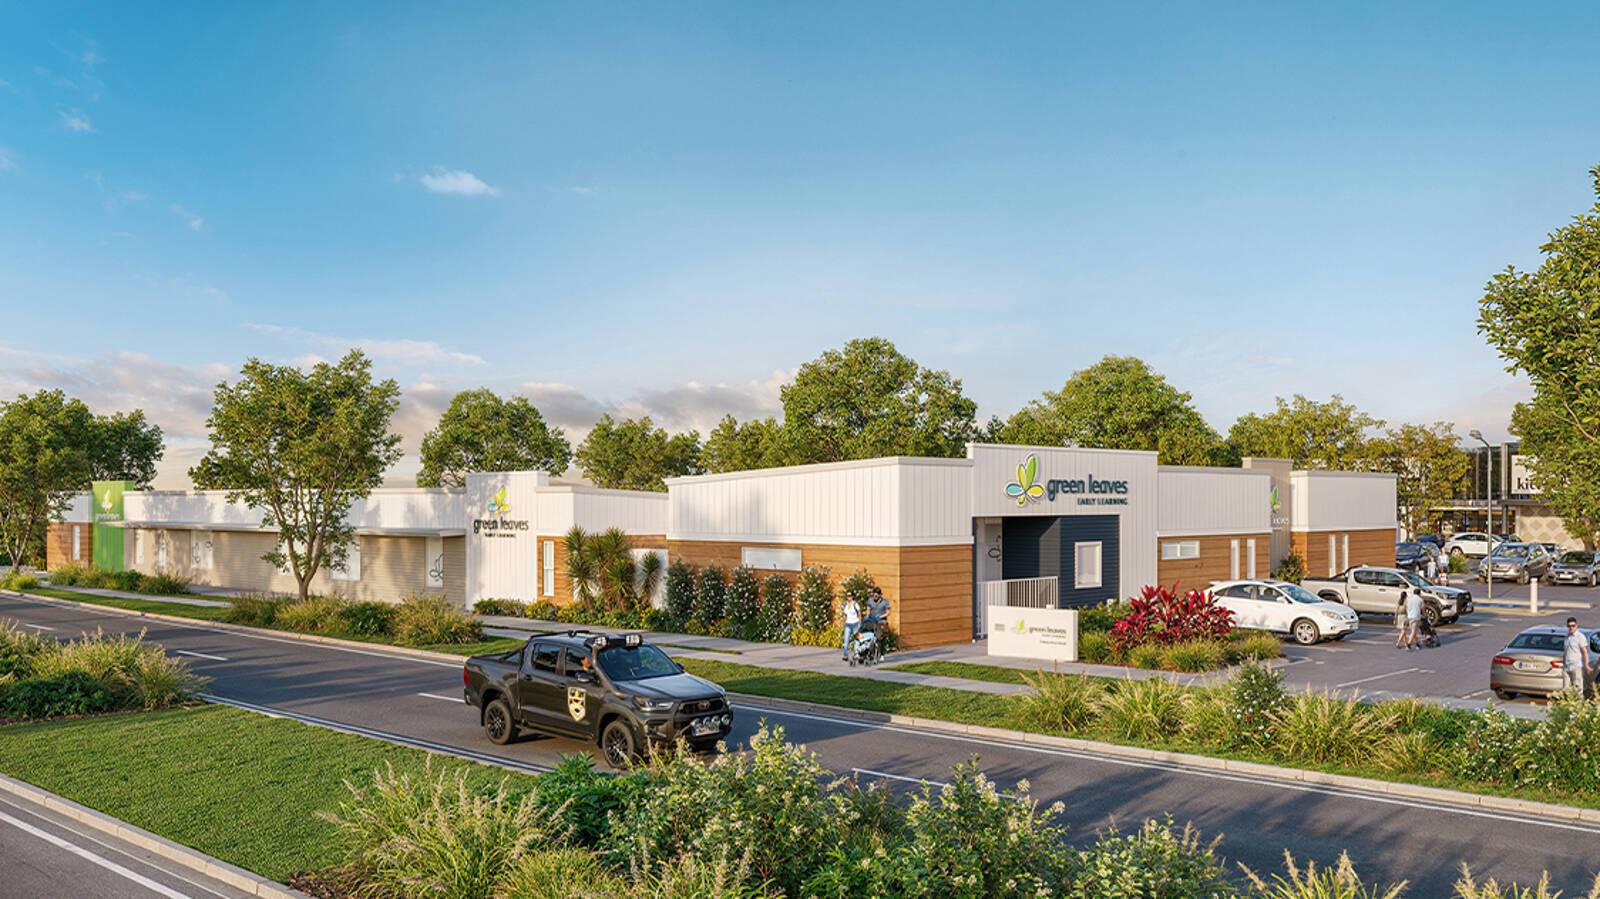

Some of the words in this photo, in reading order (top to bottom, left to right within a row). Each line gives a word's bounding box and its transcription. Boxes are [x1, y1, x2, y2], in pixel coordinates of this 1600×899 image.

[1047, 479, 1085, 502] green
[1088, 474, 1128, 494] leaves
[473, 519, 498, 534] green
[500, 516, 528, 530] leaves
